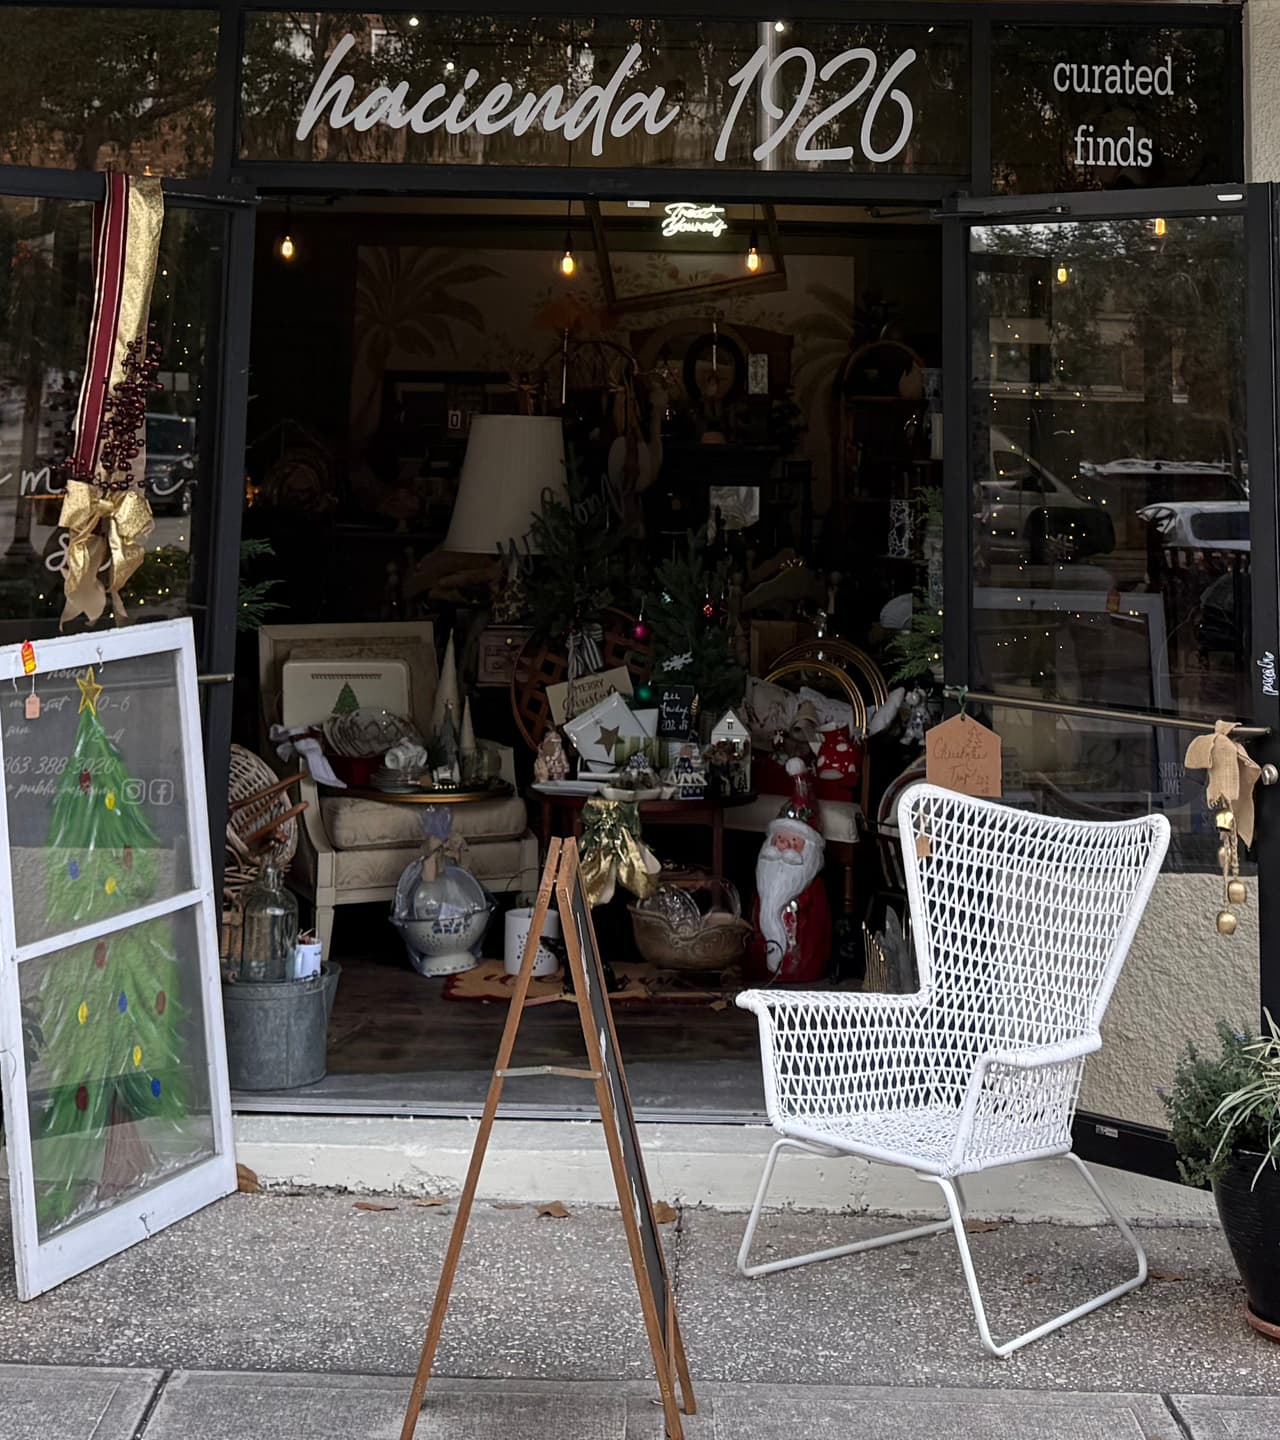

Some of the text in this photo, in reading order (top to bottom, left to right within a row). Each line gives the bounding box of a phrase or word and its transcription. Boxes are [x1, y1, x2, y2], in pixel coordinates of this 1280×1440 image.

[295, 32, 917, 165] hacienda 1926
[1052, 55, 1175, 97] curated
[1073, 123, 1155, 169] finds
